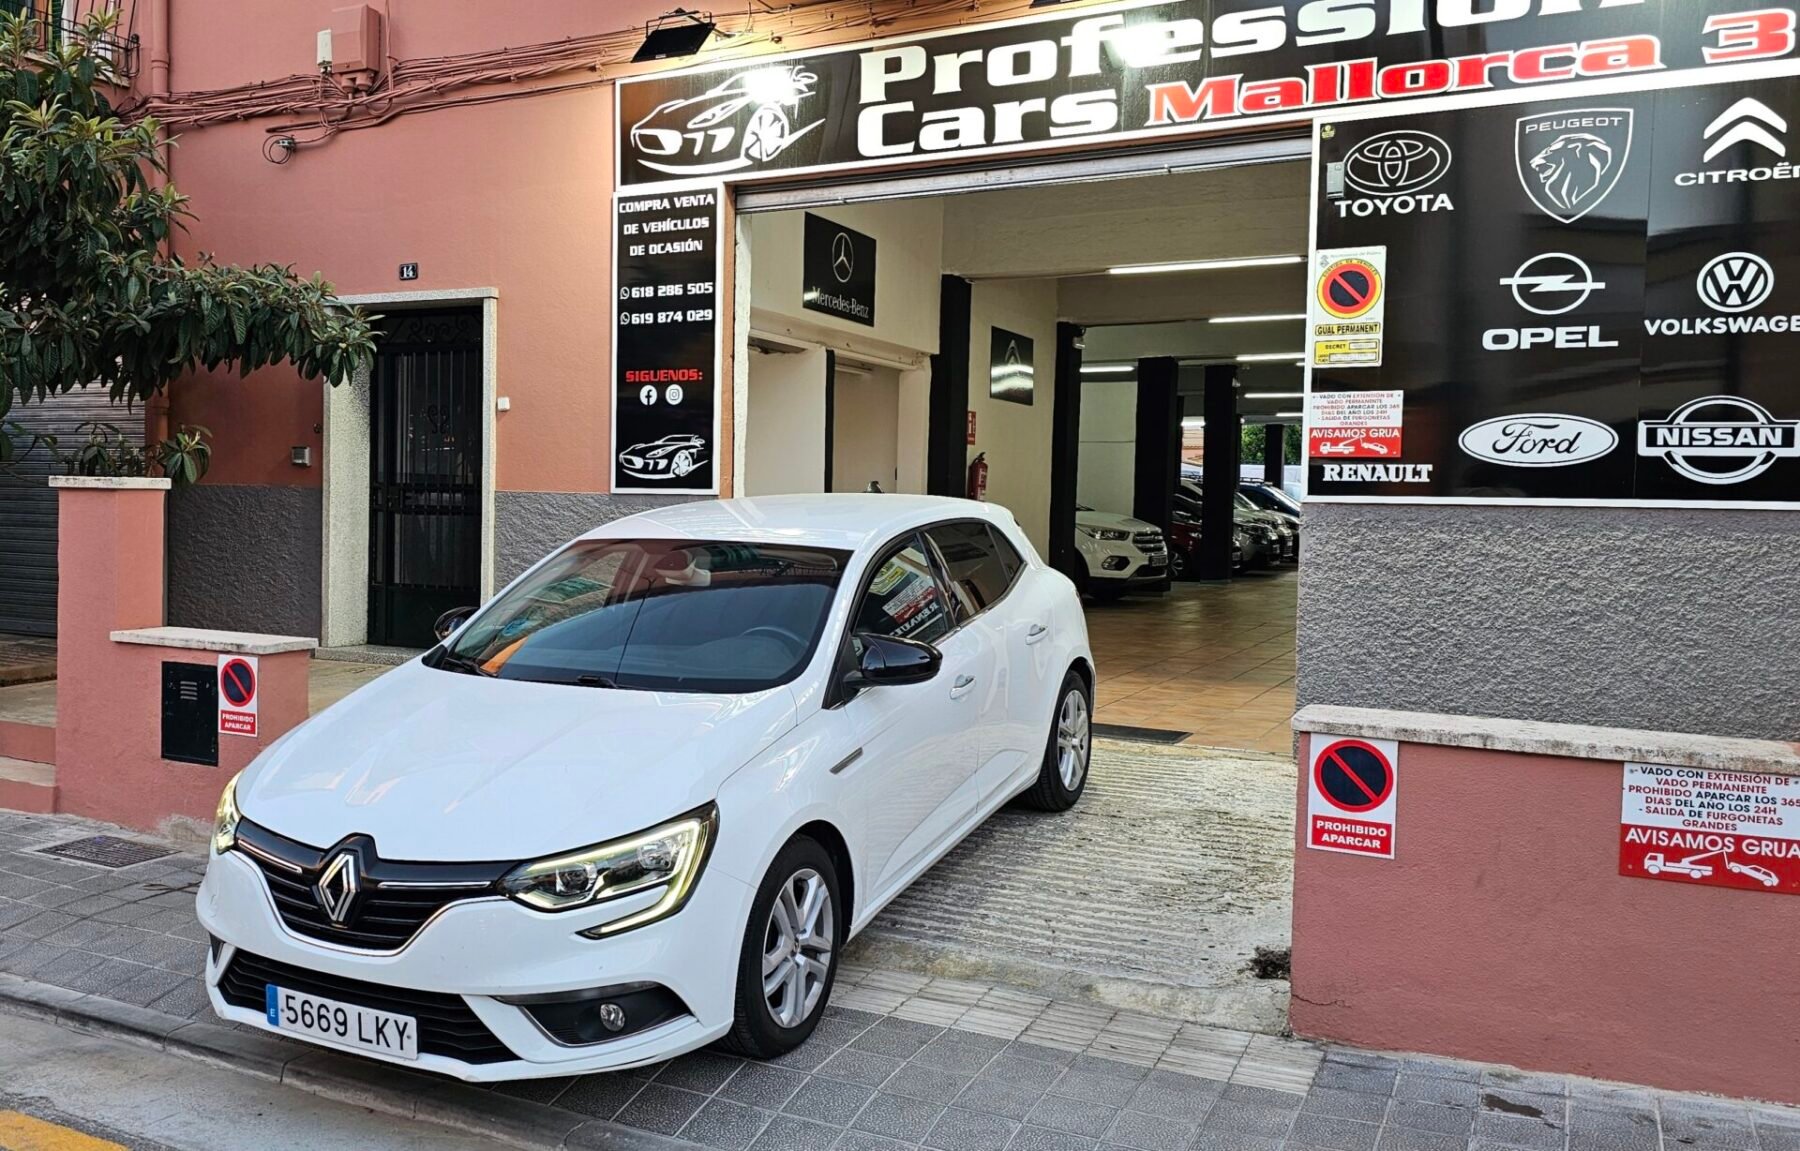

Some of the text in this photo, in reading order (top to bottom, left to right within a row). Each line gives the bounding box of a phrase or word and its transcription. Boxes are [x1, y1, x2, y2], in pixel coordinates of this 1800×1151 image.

[857, 7, 1797, 158] Cars Mallorca 3
[1525, 117, 1623, 134] PEUGEOT
[619, 193, 715, 214] COMPRA VENTA
[1334, 193, 1455, 218] TOYOTA
[623, 216, 710, 235] DE VEHÍCULOS
[629, 238, 703, 257] DE OCASIÓN
[402, 265, 414, 279] 14
[631, 282, 714, 299] 618 286 505
[811, 286, 870, 319] Mercedes-Benz
[631, 309, 713, 325] 619 874 029
[1317, 324, 1379, 336] GUAL PERMANENT
[1482, 325, 1619, 351] OPEL
[625, 368, 704, 383] SIGUENOS:
[1311, 428, 1400, 438] AVISAMOS GRUA
[1492, 422, 1582, 455] Ford
[1656, 427, 1782, 447] NISSAN
[1322, 464, 1433, 482] RENAULT
[222, 713, 254, 723] PROHIBIDO
[224, 722, 251, 731] APARCAR
[1640, 766, 1790, 786] VADO CON EXTENSIÓN DE
[1628, 785, 1692, 798] PROHIBIDO
[1695, 791, 1751, 803] APARCAR
[1755, 796, 1777, 805] LOS
[1656, 778, 1767, 794] VADO PERMANENTE
[1645, 796, 1672, 806] DIAS
[1675, 798, 1695, 808] DEL
[1728, 803, 1751, 813] LOS
[1754, 805, 1777, 815] 24H
[1645, 806, 1783, 826] SALIDA DE FURGONETAS
[1682, 818, 1738, 831] GRANDES
[1316, 820, 1388, 837] PROHIBIDO
[1321, 833, 1381, 849] APARCAR
[1625, 827, 1800, 859] AVISAMOS GRUA
[285, 994, 408, 1051] 5669 LKY
